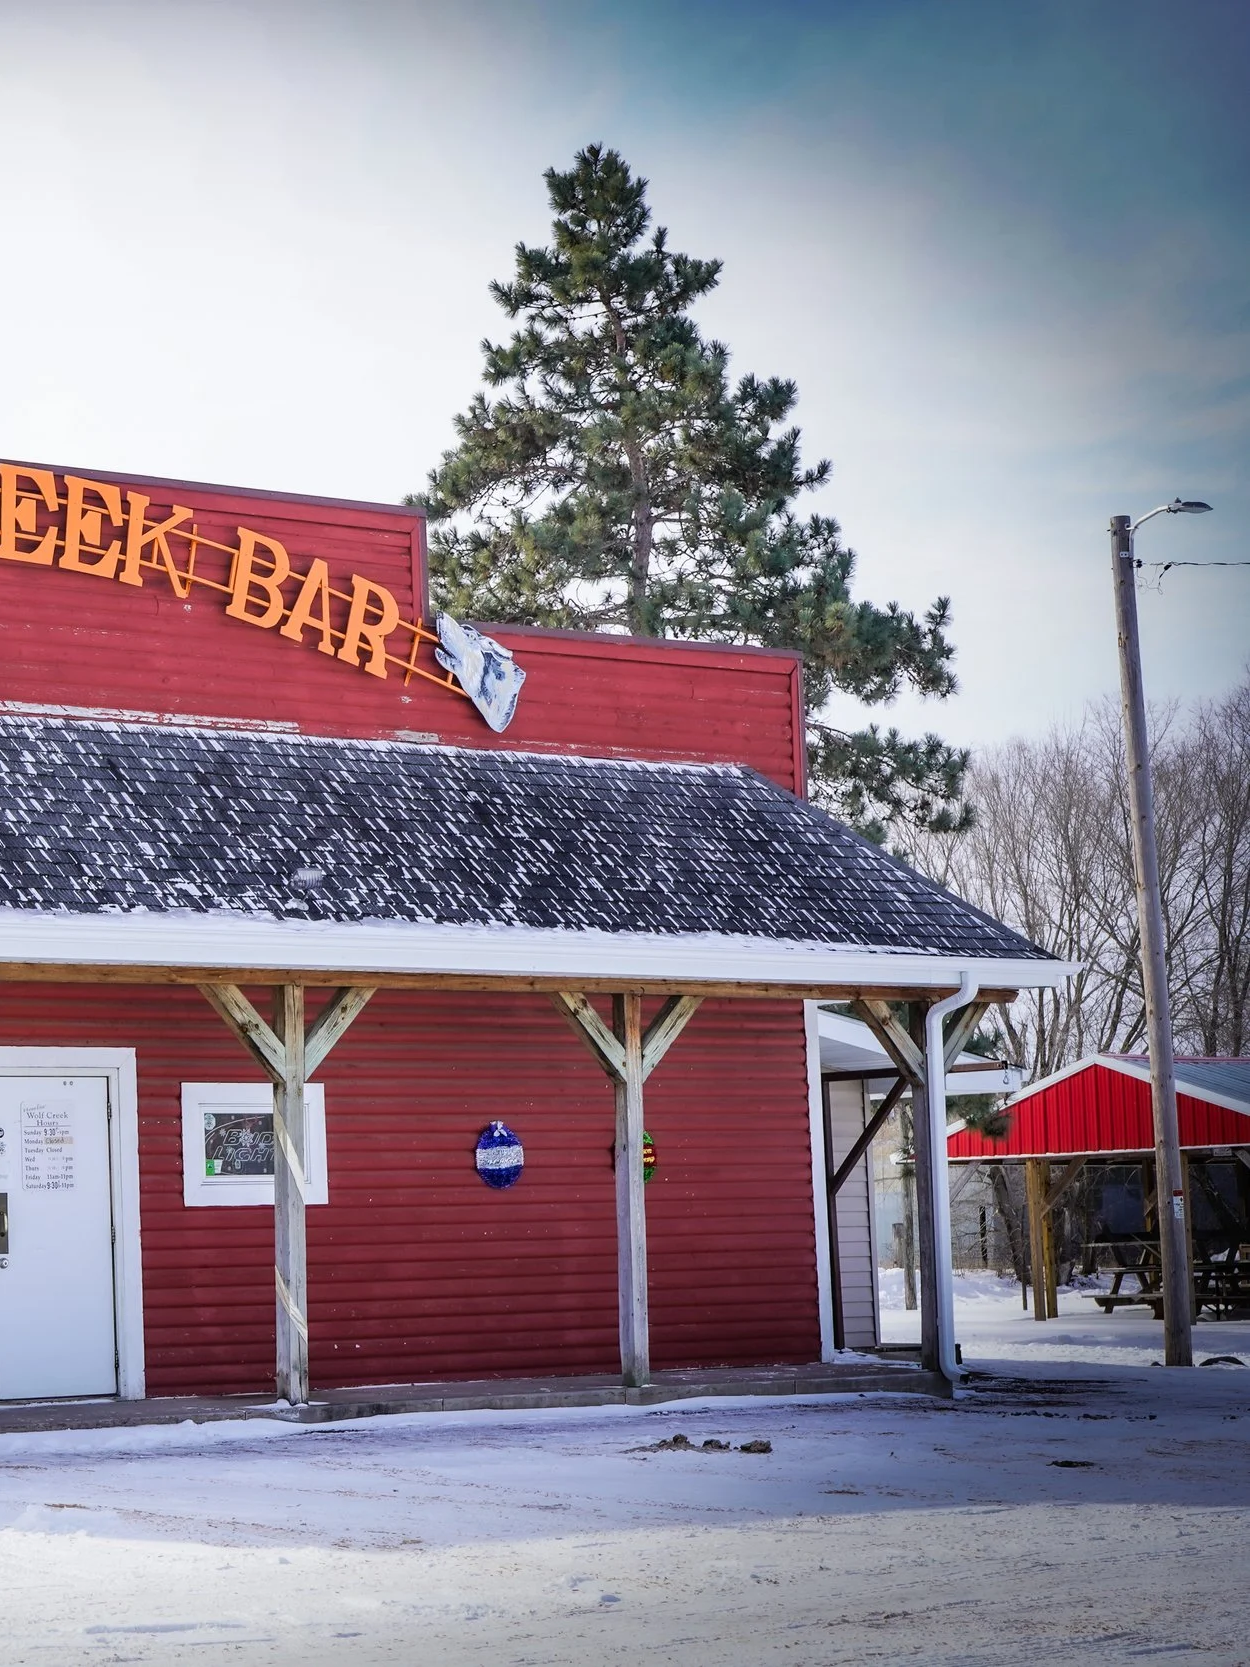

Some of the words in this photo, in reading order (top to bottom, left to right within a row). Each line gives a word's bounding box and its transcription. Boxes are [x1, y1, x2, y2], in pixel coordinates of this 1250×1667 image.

[225, 526, 400, 680] BAR
[26, 1111, 44, 1119] Wolf
[46, 1111, 69, 1119] Creek
